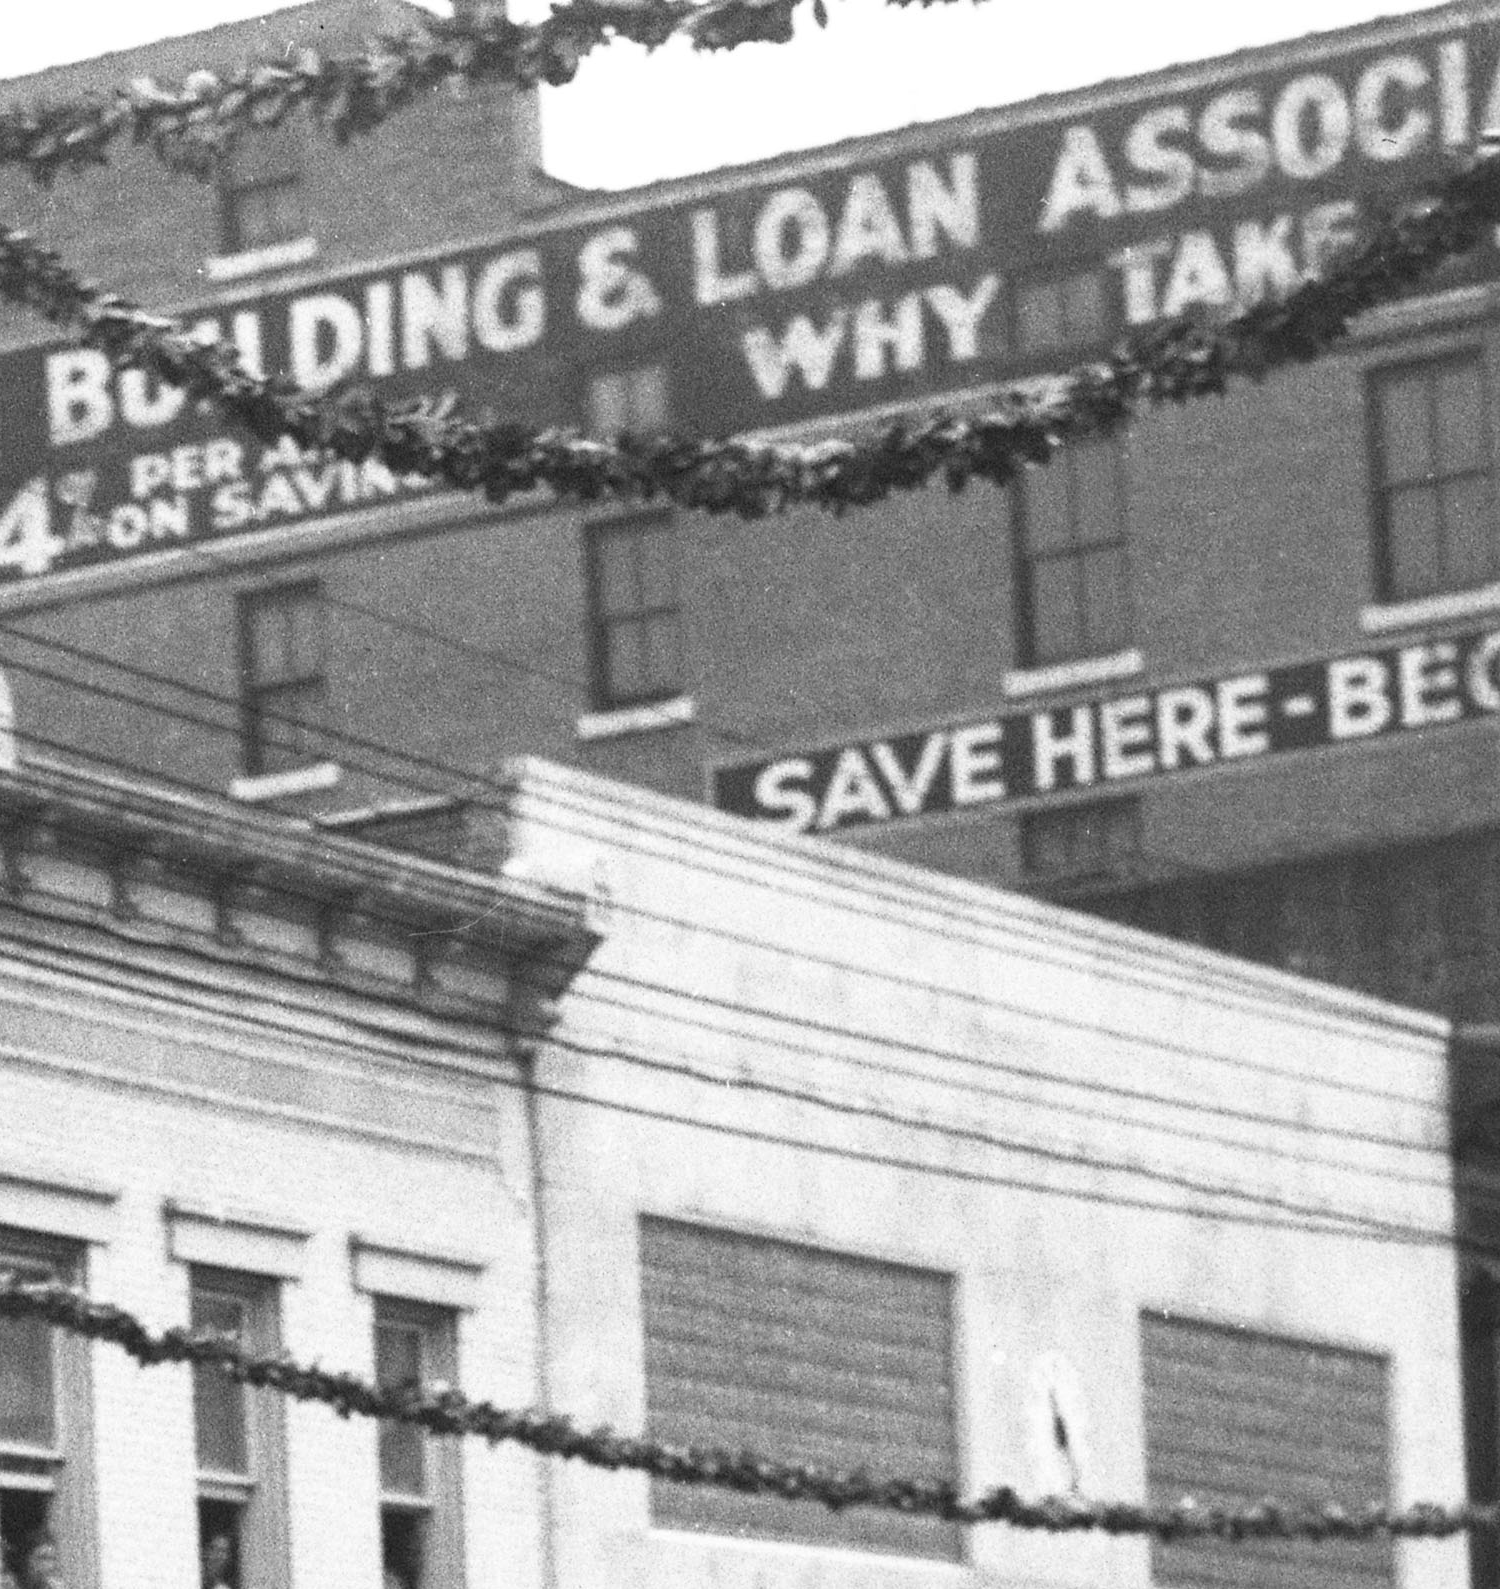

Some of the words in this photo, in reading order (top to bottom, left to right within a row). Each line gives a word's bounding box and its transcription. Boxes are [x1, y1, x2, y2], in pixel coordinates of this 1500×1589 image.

[45, 249, 544, 446] BULDING
[576, 227, 663, 331] &
[693, 153, 979, 306] LOAN
[740, 272, 999, 400] WHY
[130, 438, 243, 498] PER
[106, 501, 190, 549] ON
[754, 722, 1006, 832] SAVE
